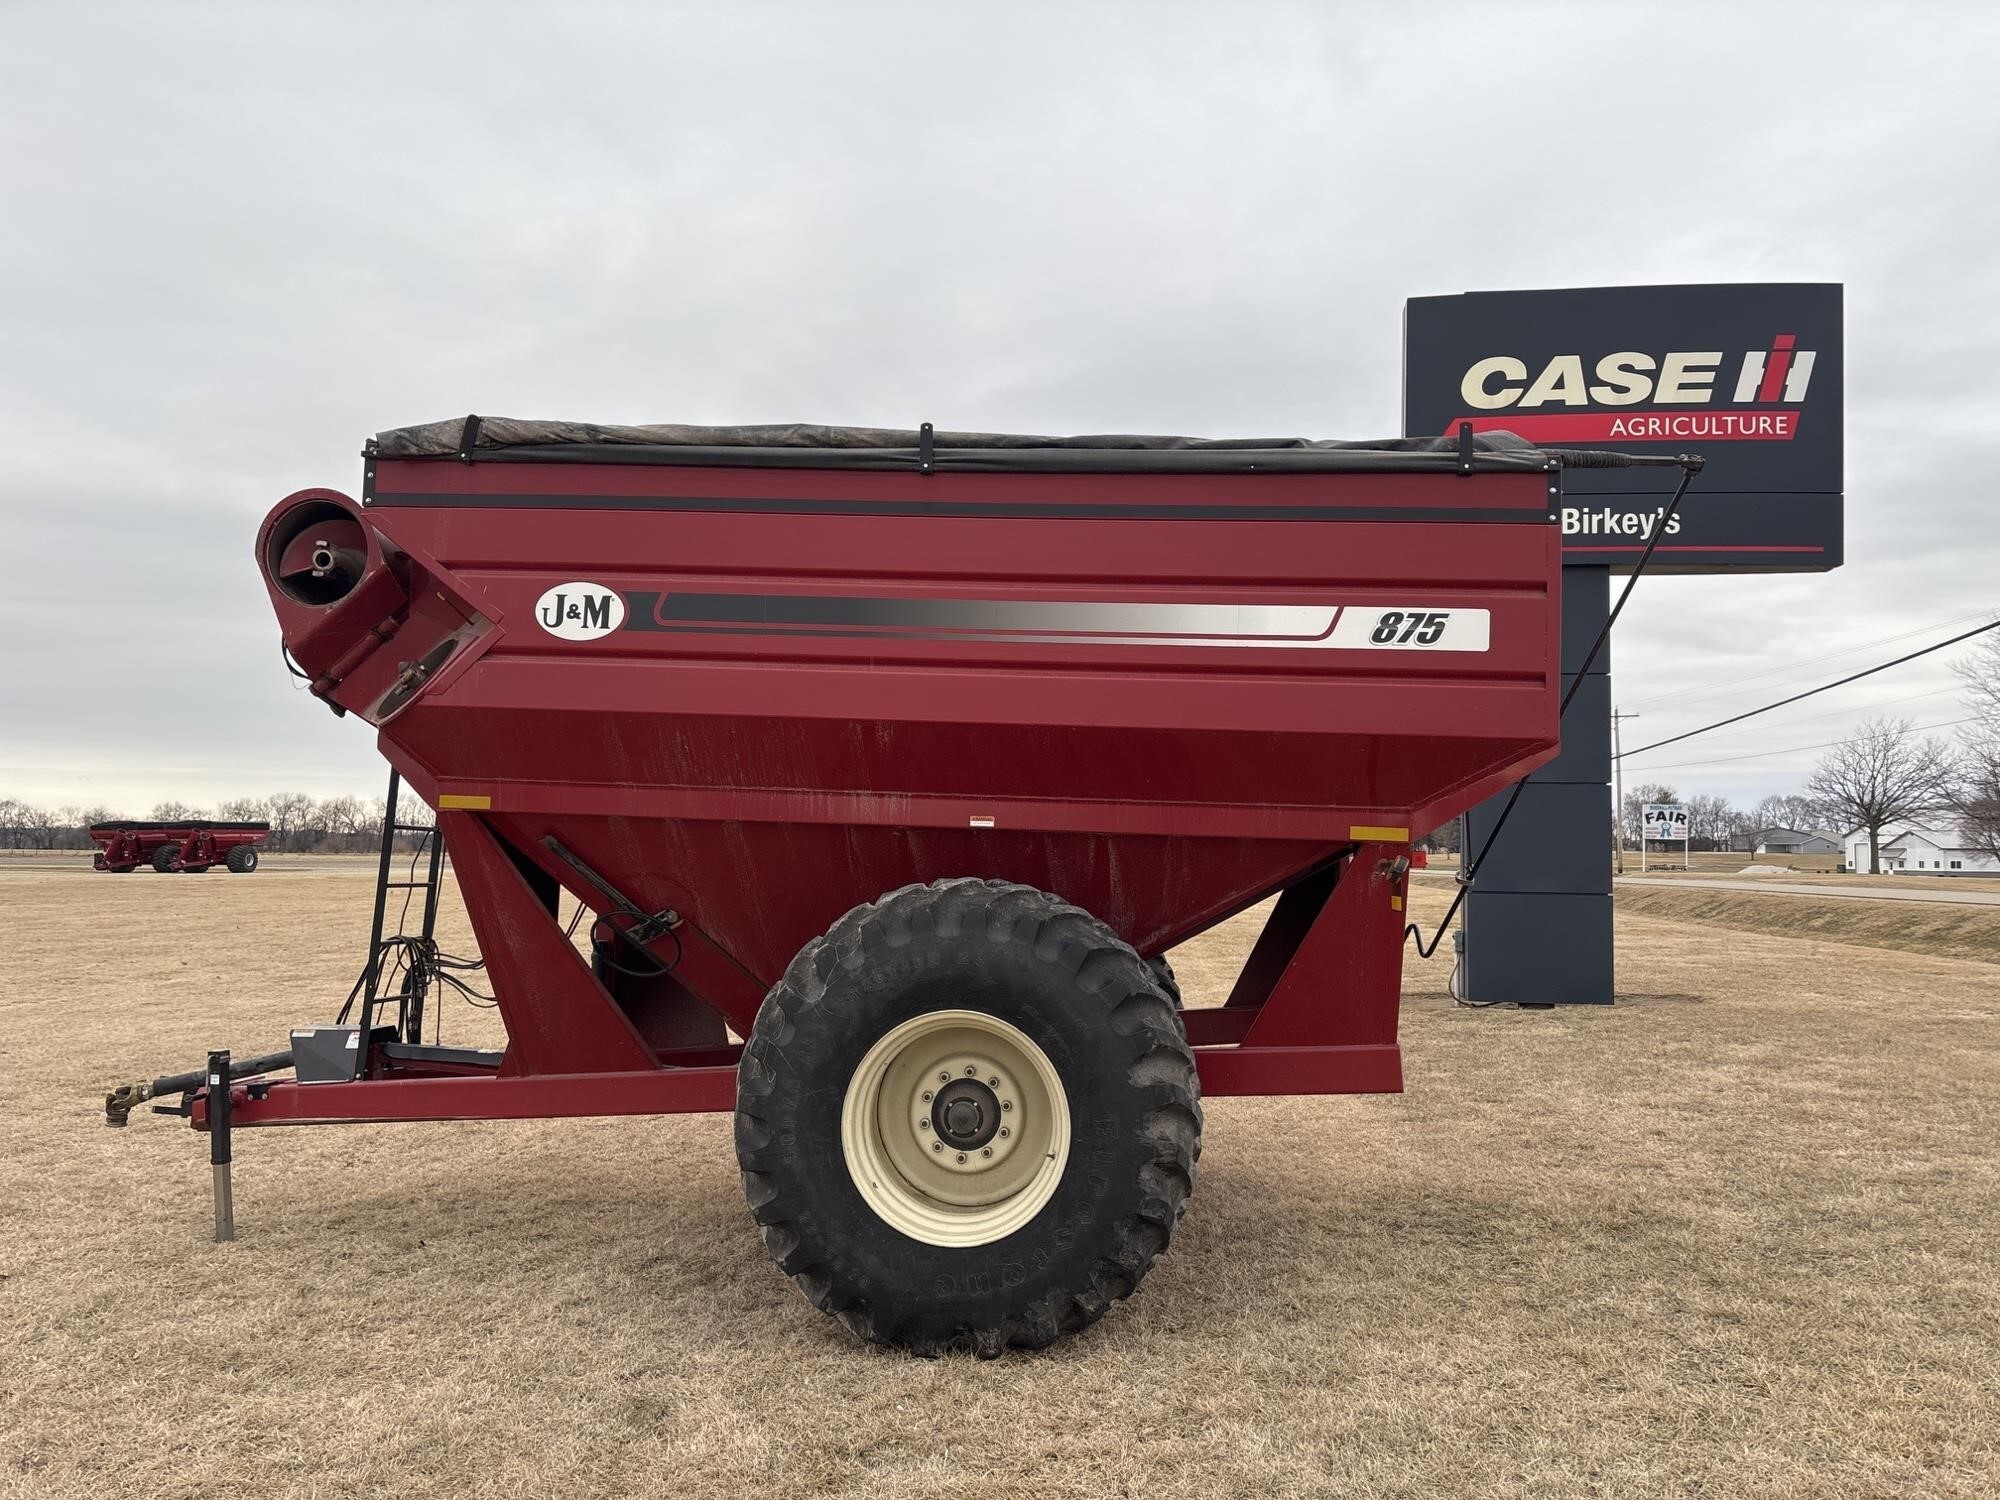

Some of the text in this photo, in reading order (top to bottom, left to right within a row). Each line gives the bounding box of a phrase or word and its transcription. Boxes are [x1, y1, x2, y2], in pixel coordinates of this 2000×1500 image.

[1460, 351, 1723, 409] CASE
[1610, 416, 1788, 437] AGRICULTURE
[1561, 507, 1681, 540] Birkey's
[542, 593, 613, 629] J&M
[1370, 611, 1450, 645] 875
[1645, 811, 1687, 825] FAIR
